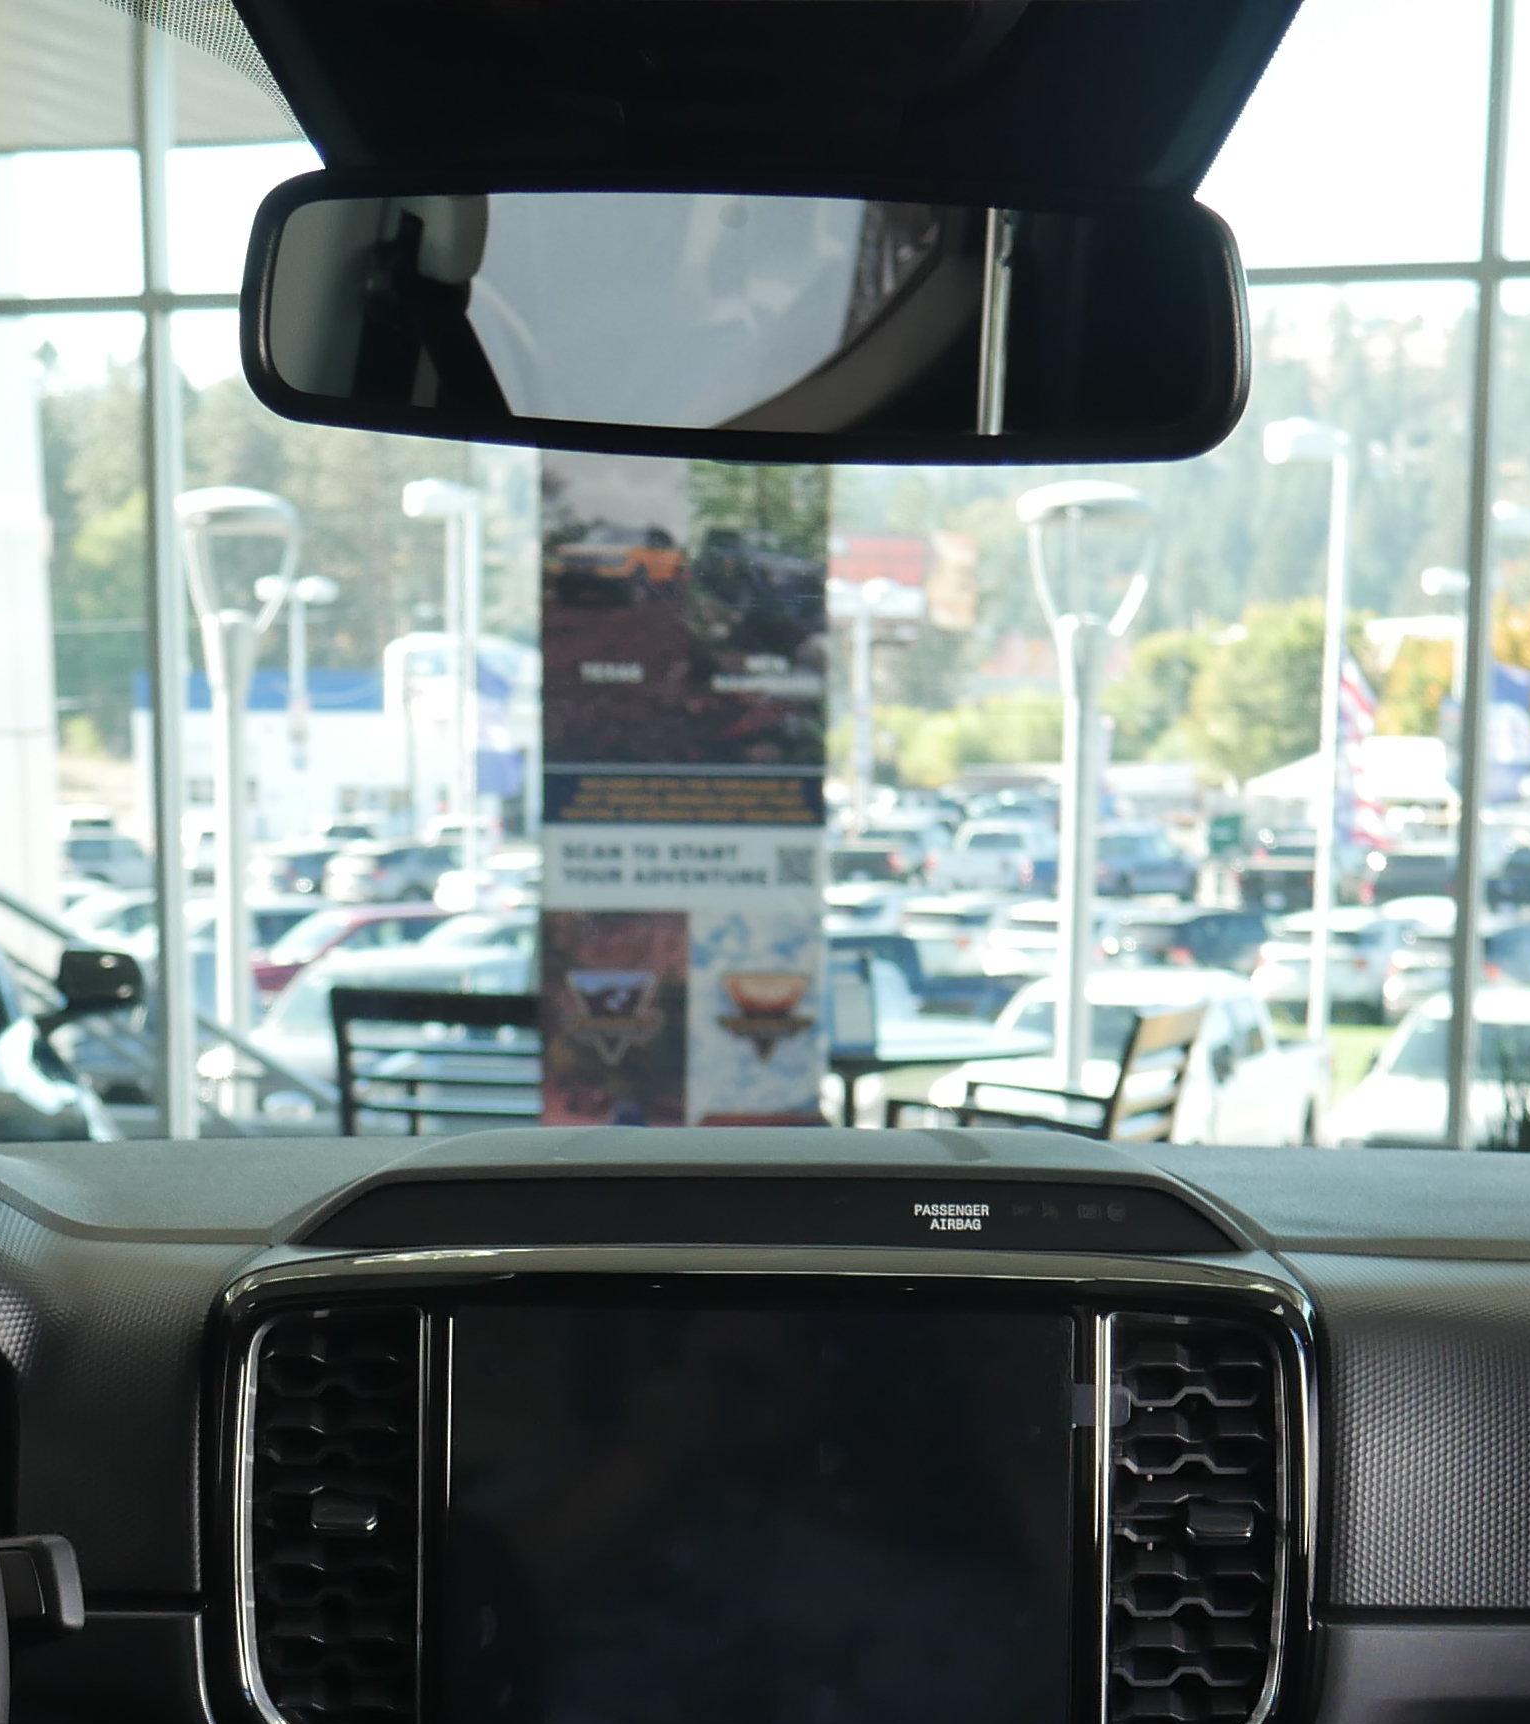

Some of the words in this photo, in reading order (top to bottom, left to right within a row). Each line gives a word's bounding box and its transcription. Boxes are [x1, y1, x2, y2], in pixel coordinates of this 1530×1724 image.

[562, 843, 623, 860] SCAN
[632, 844, 659, 860] TO
[633, 867, 767, 884] ADVENTURE
[914, 1203, 990, 1217] PASSENGER
[929, 1218, 982, 1231] AIRBAG
